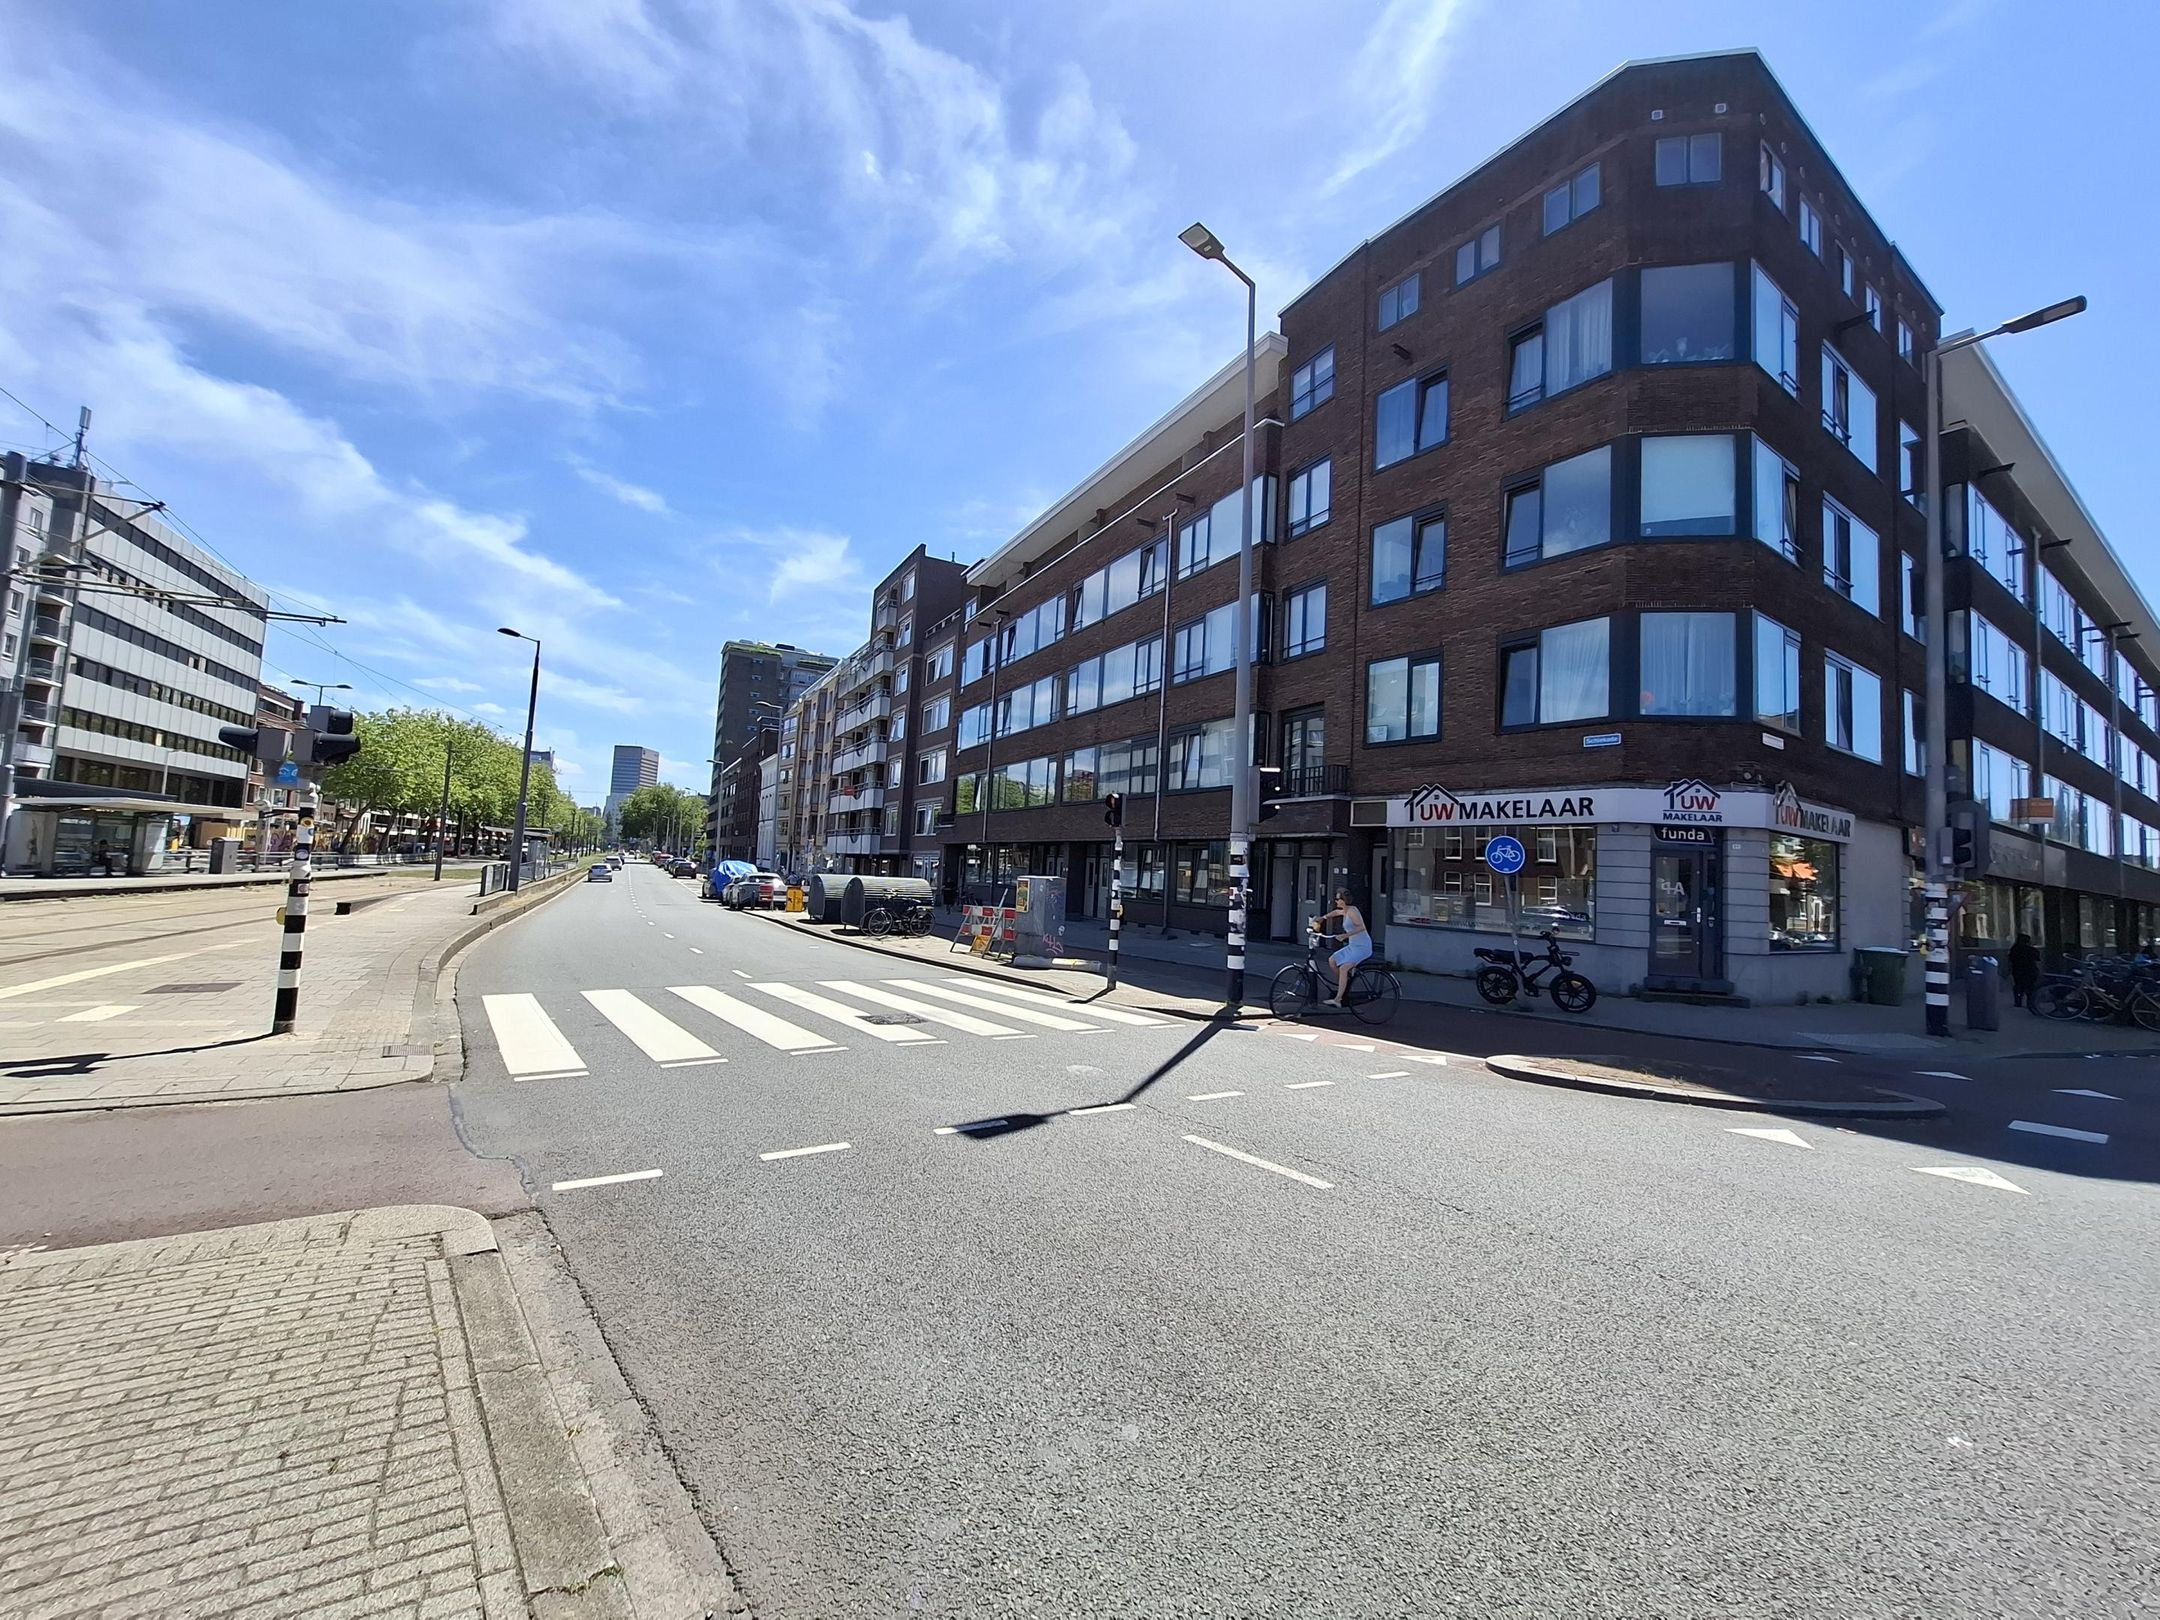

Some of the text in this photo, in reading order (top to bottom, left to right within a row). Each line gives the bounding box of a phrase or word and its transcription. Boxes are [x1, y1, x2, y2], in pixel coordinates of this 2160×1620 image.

[1420, 797, 1595, 821] UW MAKELAAR
[1680, 795, 1716, 811] UW
[1662, 812, 1723, 823] MAKELAAR
[1661, 827, 1705, 841] funda
